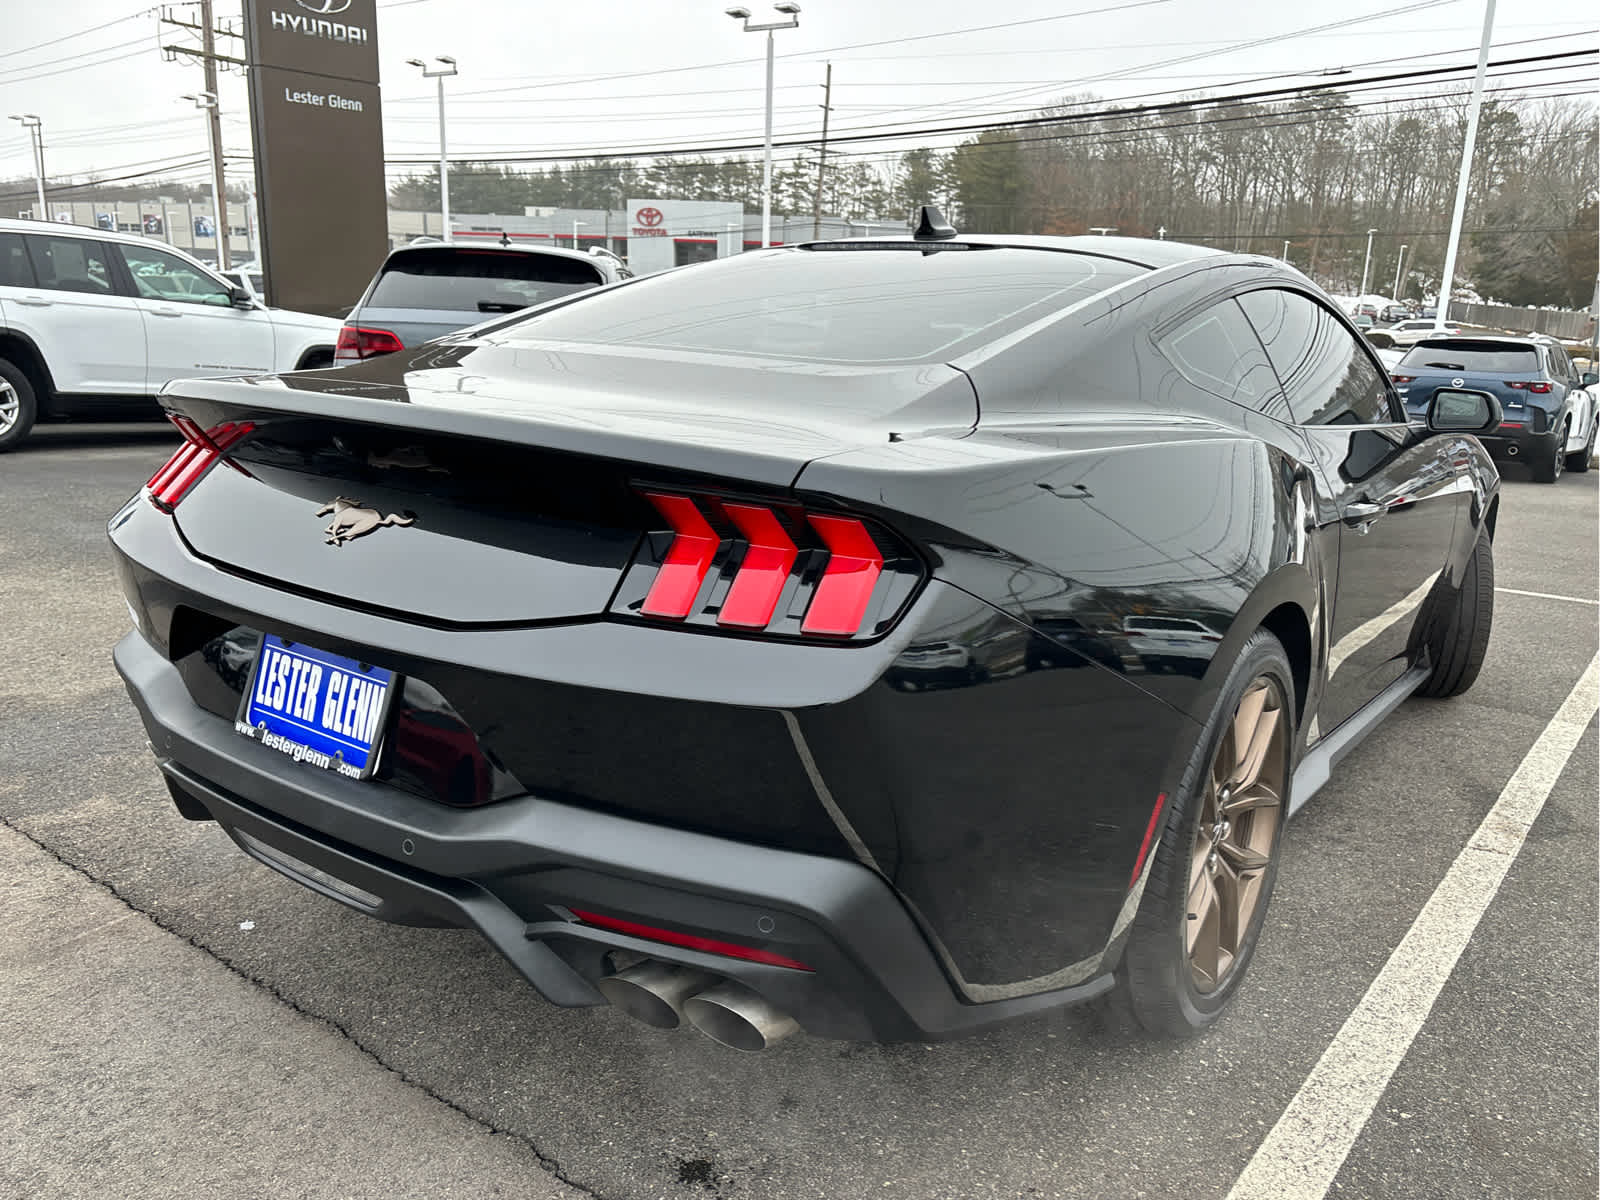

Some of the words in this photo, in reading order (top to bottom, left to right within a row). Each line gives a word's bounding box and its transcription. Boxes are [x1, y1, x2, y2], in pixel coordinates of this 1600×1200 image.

[271, 11, 367, 45] HYUNDAI
[285, 87, 325, 106] Lester
[328, 94, 363, 112] Glenn
[632, 227, 667, 236] TOYOTA
[256, 649, 322, 723] LESTER
[322, 671, 386, 744] GLENN
[262, 730, 329, 769] lesterglenn
[337, 764, 361, 779] .com
